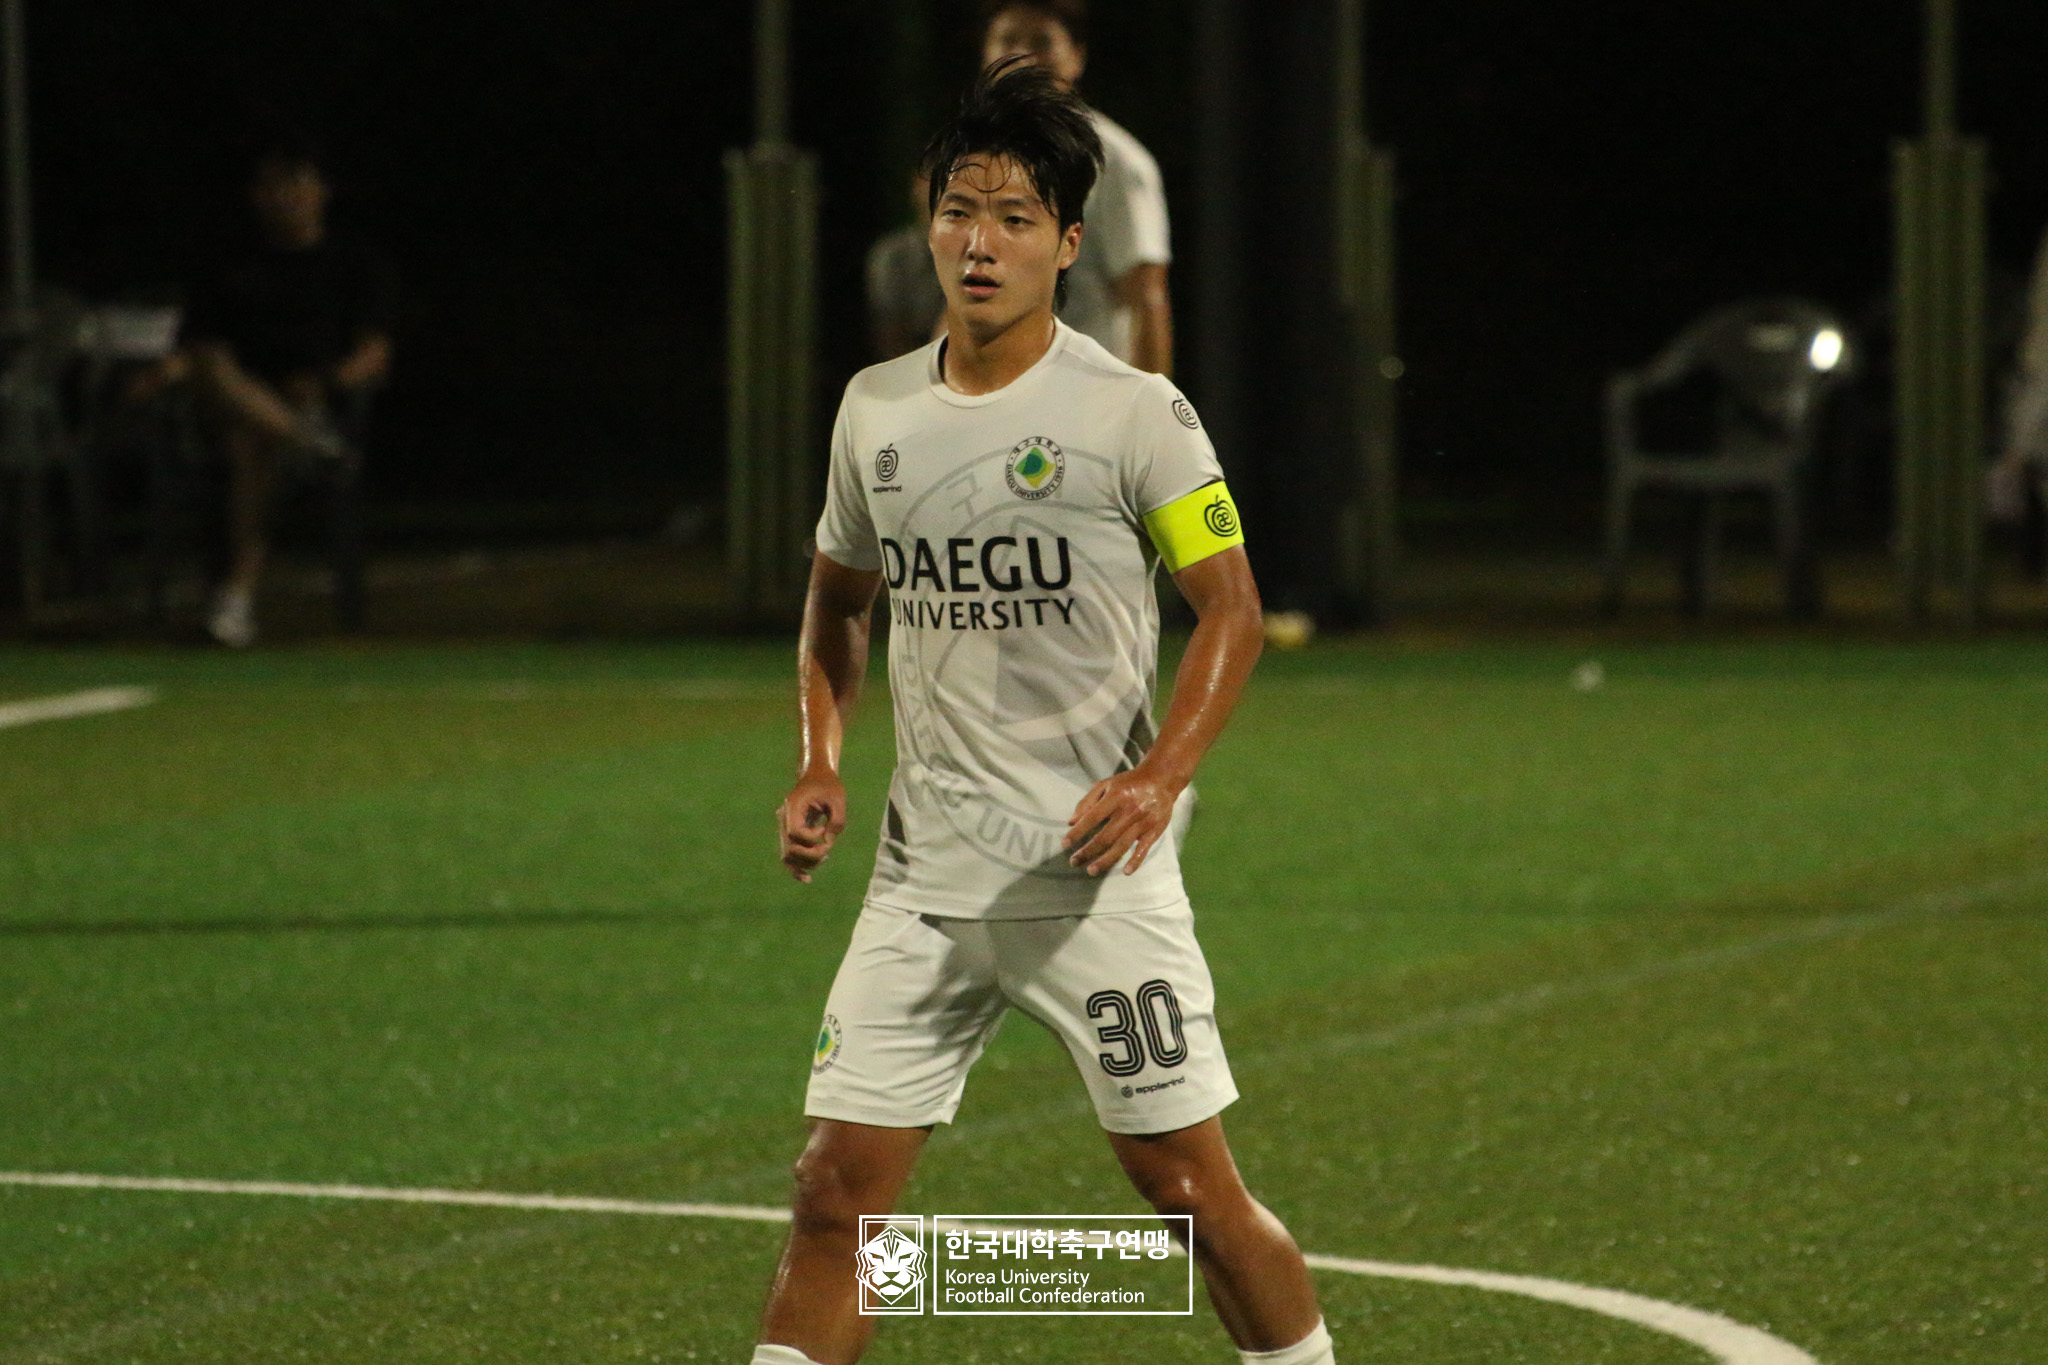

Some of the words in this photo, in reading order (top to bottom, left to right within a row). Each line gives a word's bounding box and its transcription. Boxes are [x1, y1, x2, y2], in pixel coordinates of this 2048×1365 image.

[881, 536, 1072, 592] DAEGU
[892, 598, 1075, 630] UNIVERSITY
[1086, 979, 1188, 1077] 30
